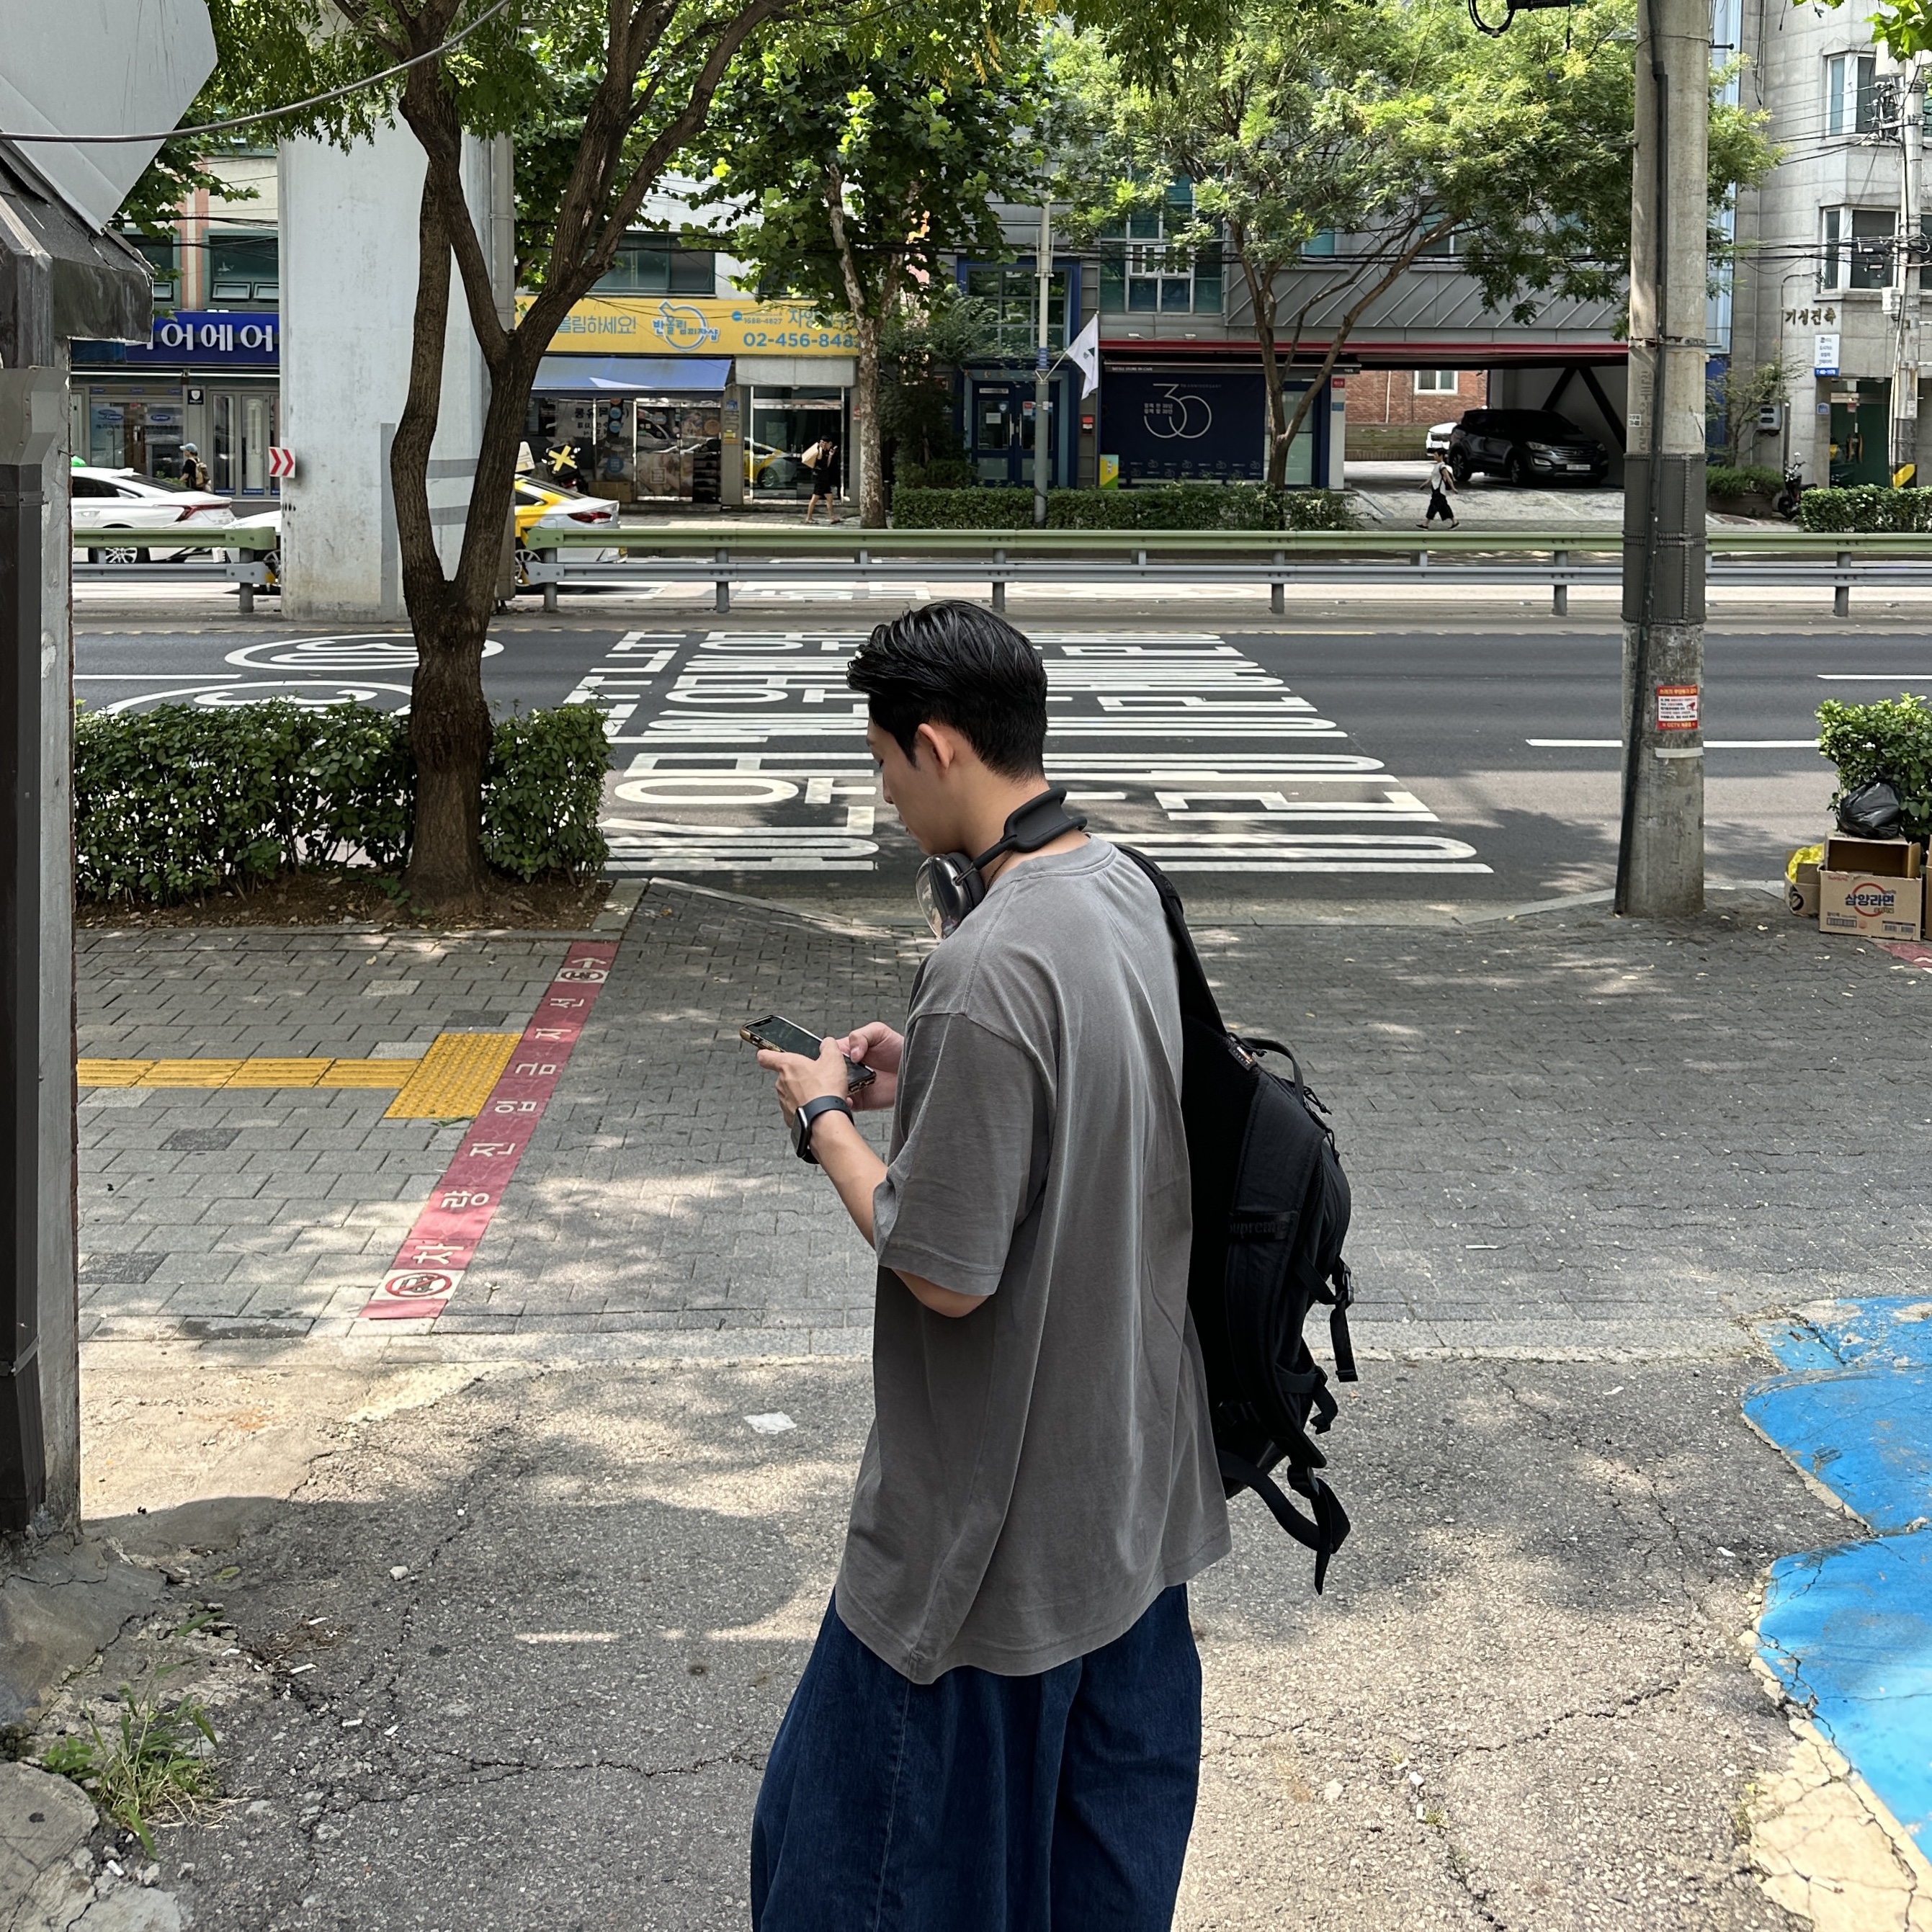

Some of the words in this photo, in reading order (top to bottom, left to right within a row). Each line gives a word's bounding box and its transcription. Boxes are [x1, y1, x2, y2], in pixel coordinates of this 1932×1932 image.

[146, 323, 273, 352] 어에어
[743, 332, 860, 348] 02-456-848
[1845, 893, 1895, 907] 삼양라면
